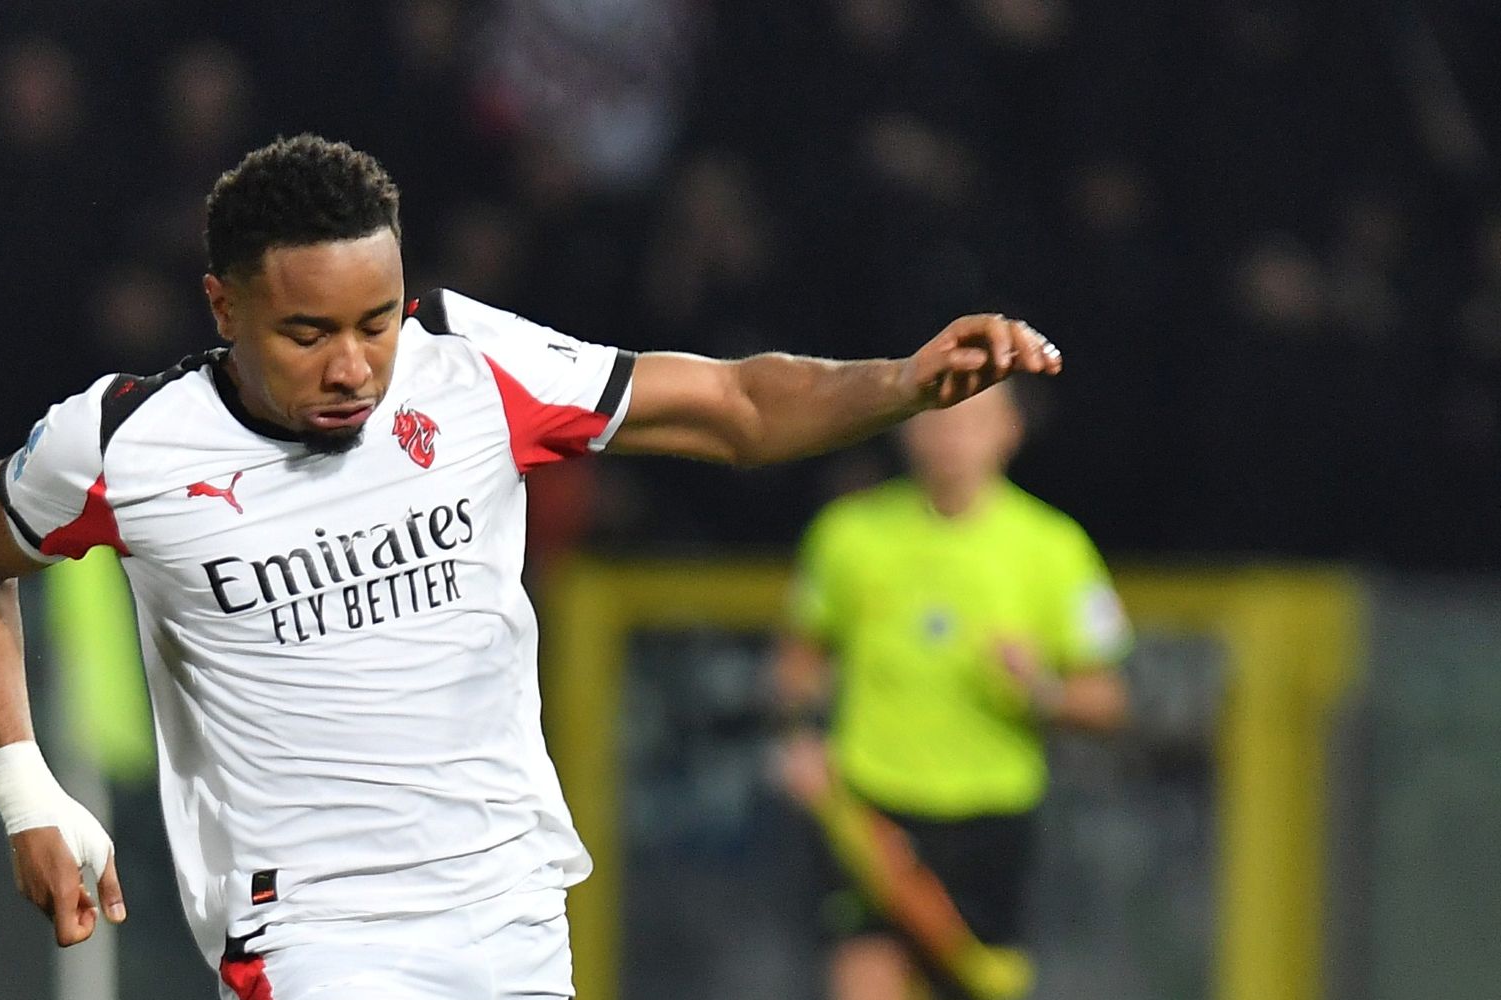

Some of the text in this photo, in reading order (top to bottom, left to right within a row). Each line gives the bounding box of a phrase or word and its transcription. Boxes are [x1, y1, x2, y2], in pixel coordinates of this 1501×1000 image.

[202, 498, 472, 613] Emirates
[271, 559, 461, 644] FLY BETTER
